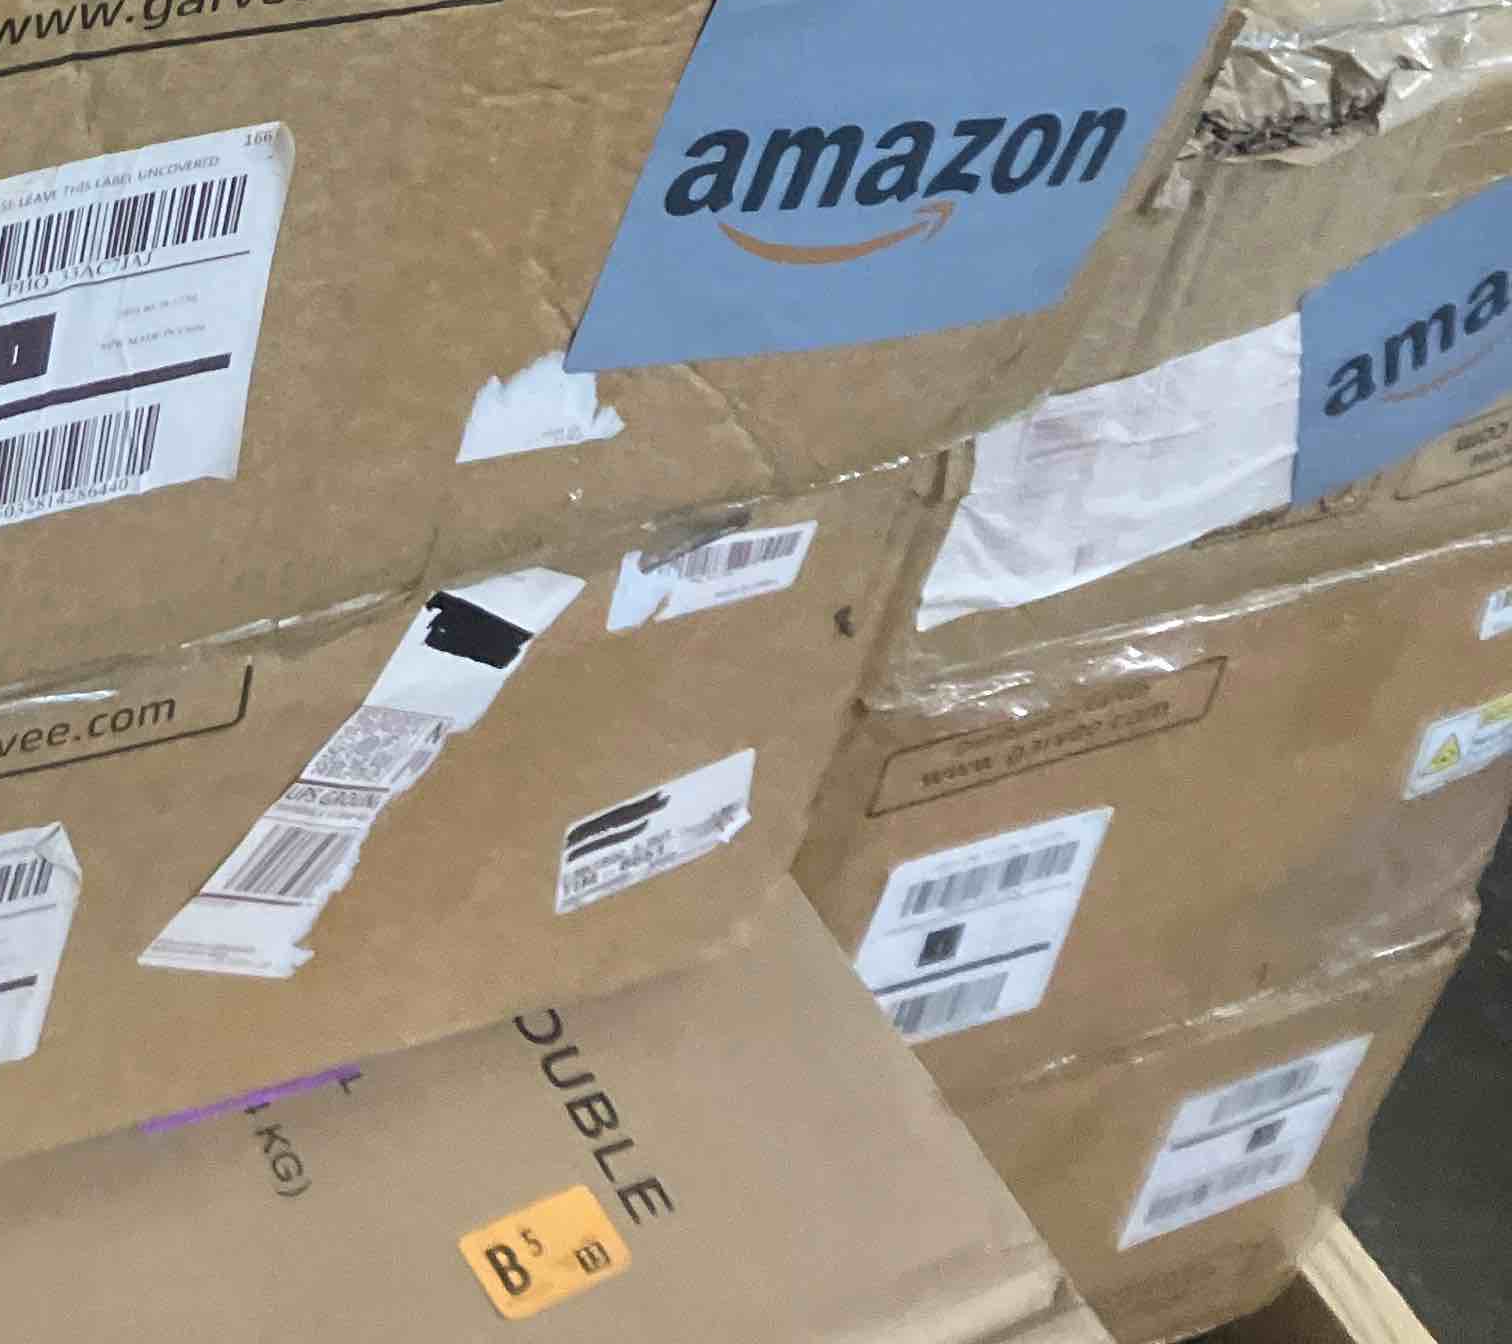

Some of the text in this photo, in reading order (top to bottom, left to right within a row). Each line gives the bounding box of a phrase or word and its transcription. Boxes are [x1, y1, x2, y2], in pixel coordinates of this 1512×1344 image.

[19, 190, 58, 208] LEAVE
[95, 173, 132, 189] LABEL
[138, 156, 222, 182] UNCOVERED
[664, 106, 1128, 216] amazon
[1324, 270, 1511, 416] ama
